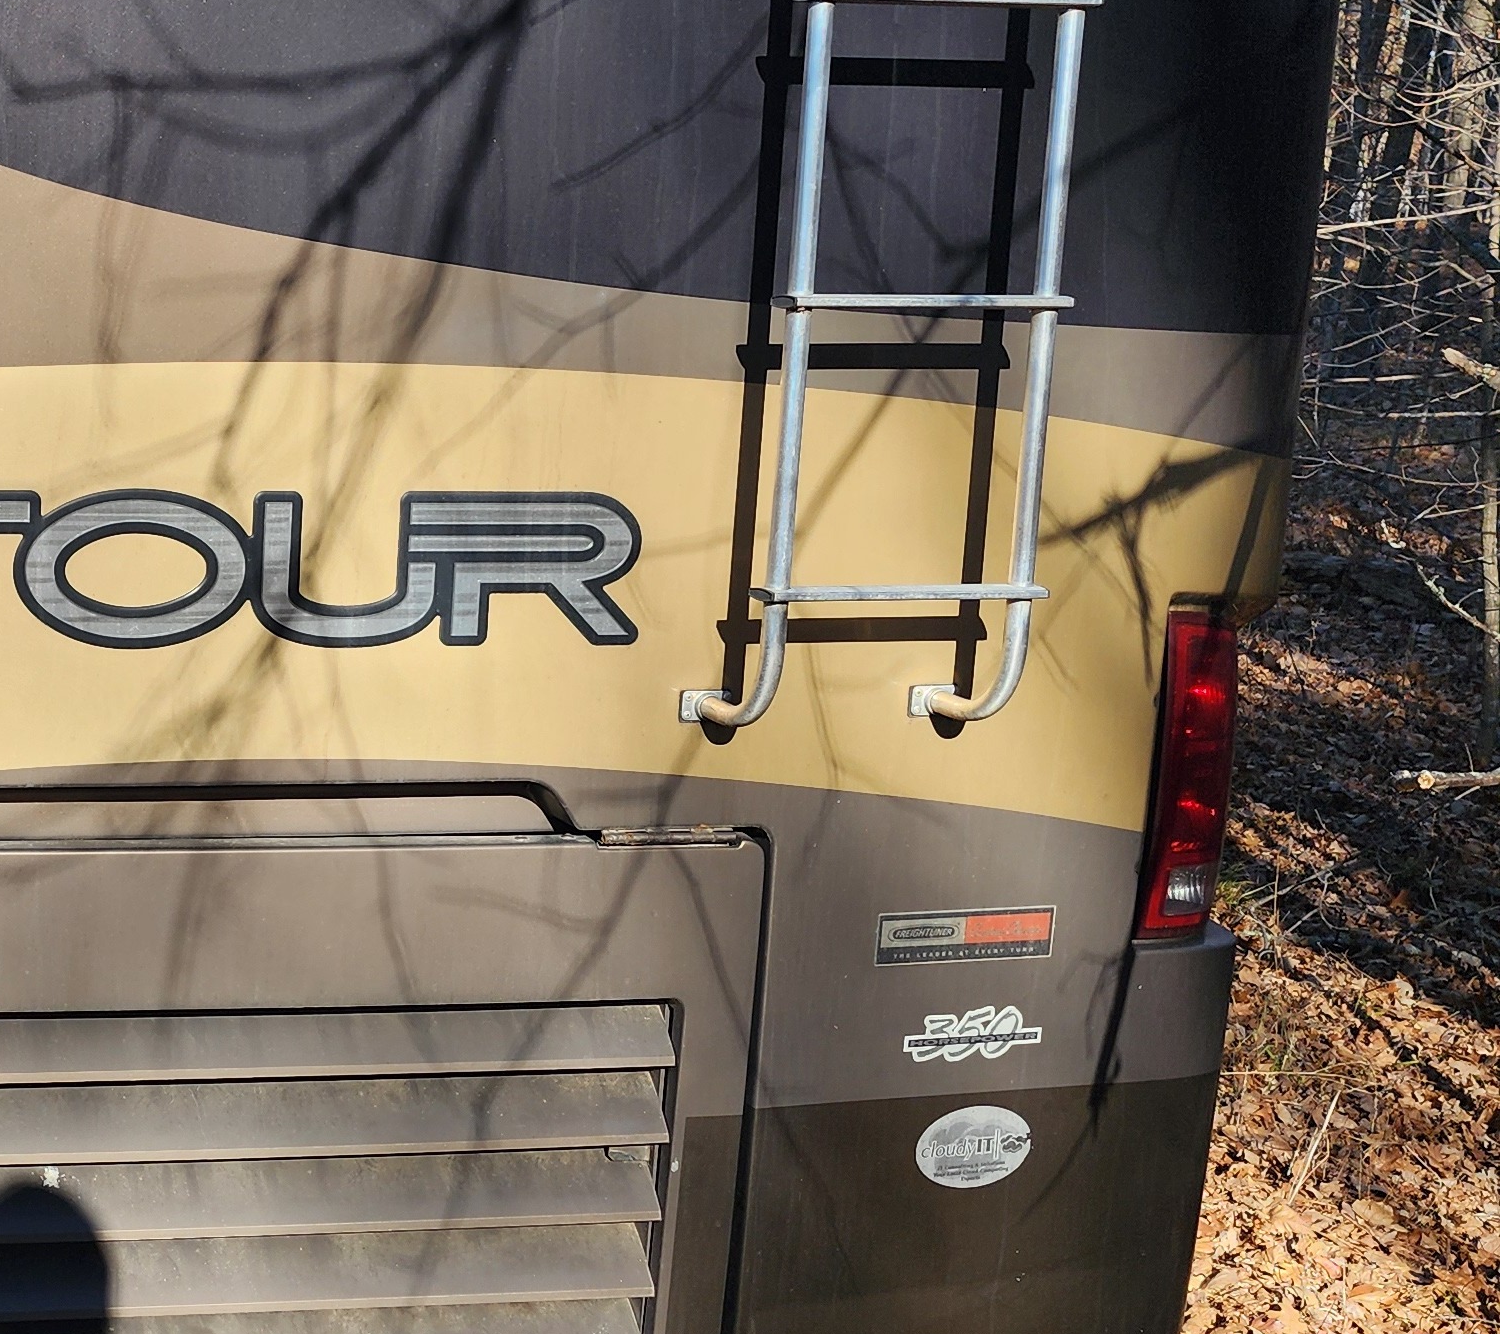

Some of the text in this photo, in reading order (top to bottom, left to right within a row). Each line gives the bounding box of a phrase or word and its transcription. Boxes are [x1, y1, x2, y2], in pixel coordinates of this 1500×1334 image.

[894, 926, 953, 938] FREIGHTLINER
[959, 949, 969, 957] AT
[909, 1032, 1038, 1047] HORSEPOWER
[914, 1007, 1021, 1060] 350
[921, 1136, 994, 1160] cloudyIT
